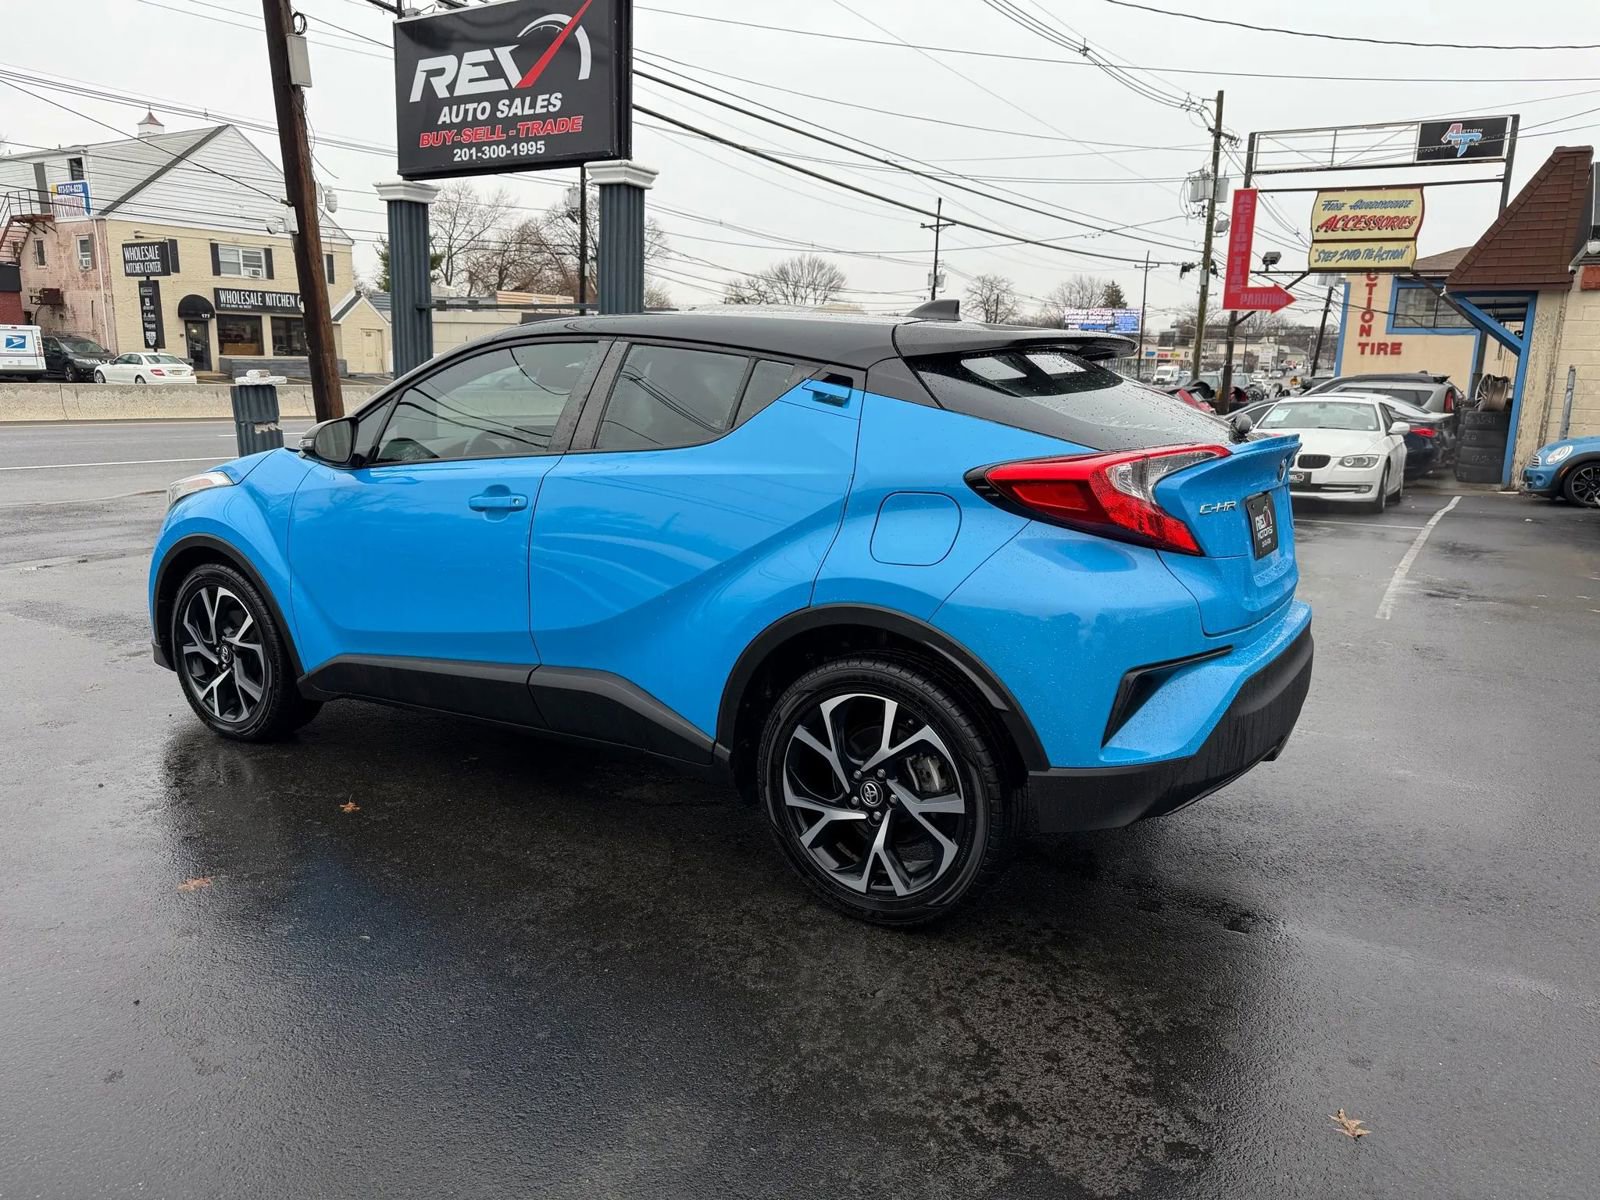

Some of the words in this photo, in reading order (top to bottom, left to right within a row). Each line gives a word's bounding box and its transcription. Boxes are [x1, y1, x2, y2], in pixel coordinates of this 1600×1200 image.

[409, 43, 551, 103] REV
[437, 100, 491, 125] AUTO
[496, 92, 563, 119] SALES
[453, 140, 546, 162] 201-300-1995
[1233, 194, 1251, 252] ACTION
[1315, 214, 1418, 233] ACCESSORIES
[123, 245, 160, 261] WHOLESALE
[125, 262, 144, 274] KITCHEN
[144, 261, 162, 273] CENTER
[219, 289, 263, 306] WHOLESALE
[265, 293, 295, 308] KITCHEN
[1240, 293, 1287, 305] PARKING
[1359, 272, 1379, 337] CTION
[1358, 342, 1402, 355] TIRE
[1199, 500, 1237, 515] C-HR
